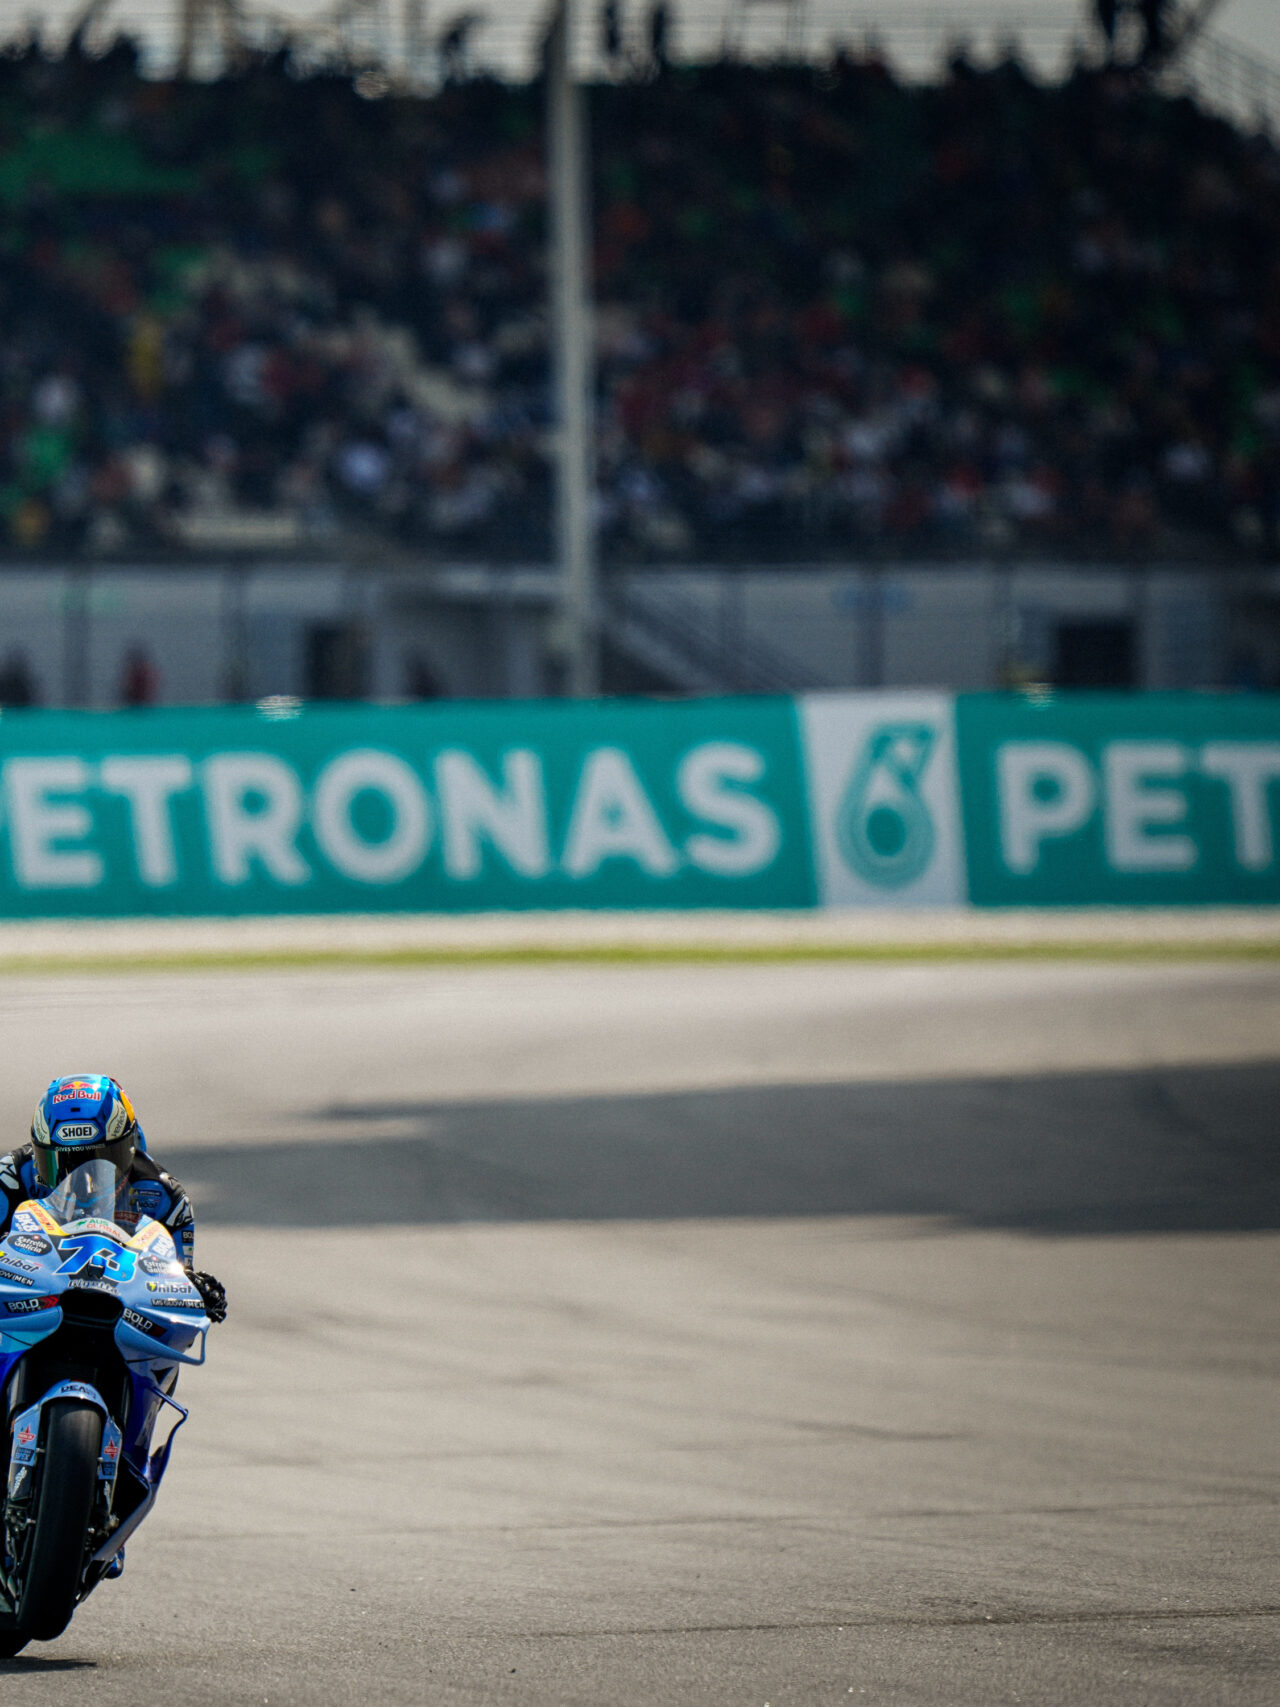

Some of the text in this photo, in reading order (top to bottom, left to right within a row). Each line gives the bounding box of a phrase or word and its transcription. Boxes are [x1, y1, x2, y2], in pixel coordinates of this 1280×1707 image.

[53, 1090, 102, 1104] Red Bull
[62, 1126, 93, 1139] SHOEI
[14, 1240, 42, 1253] Galicia
[16, 1235, 47, 1249] Estrella
[53, 1234, 139, 1283] 73
[145, 1281, 192, 1294] Unibat
[8, 1298, 39, 1310] BOLD
[123, 1307, 153, 1330] BOLD
